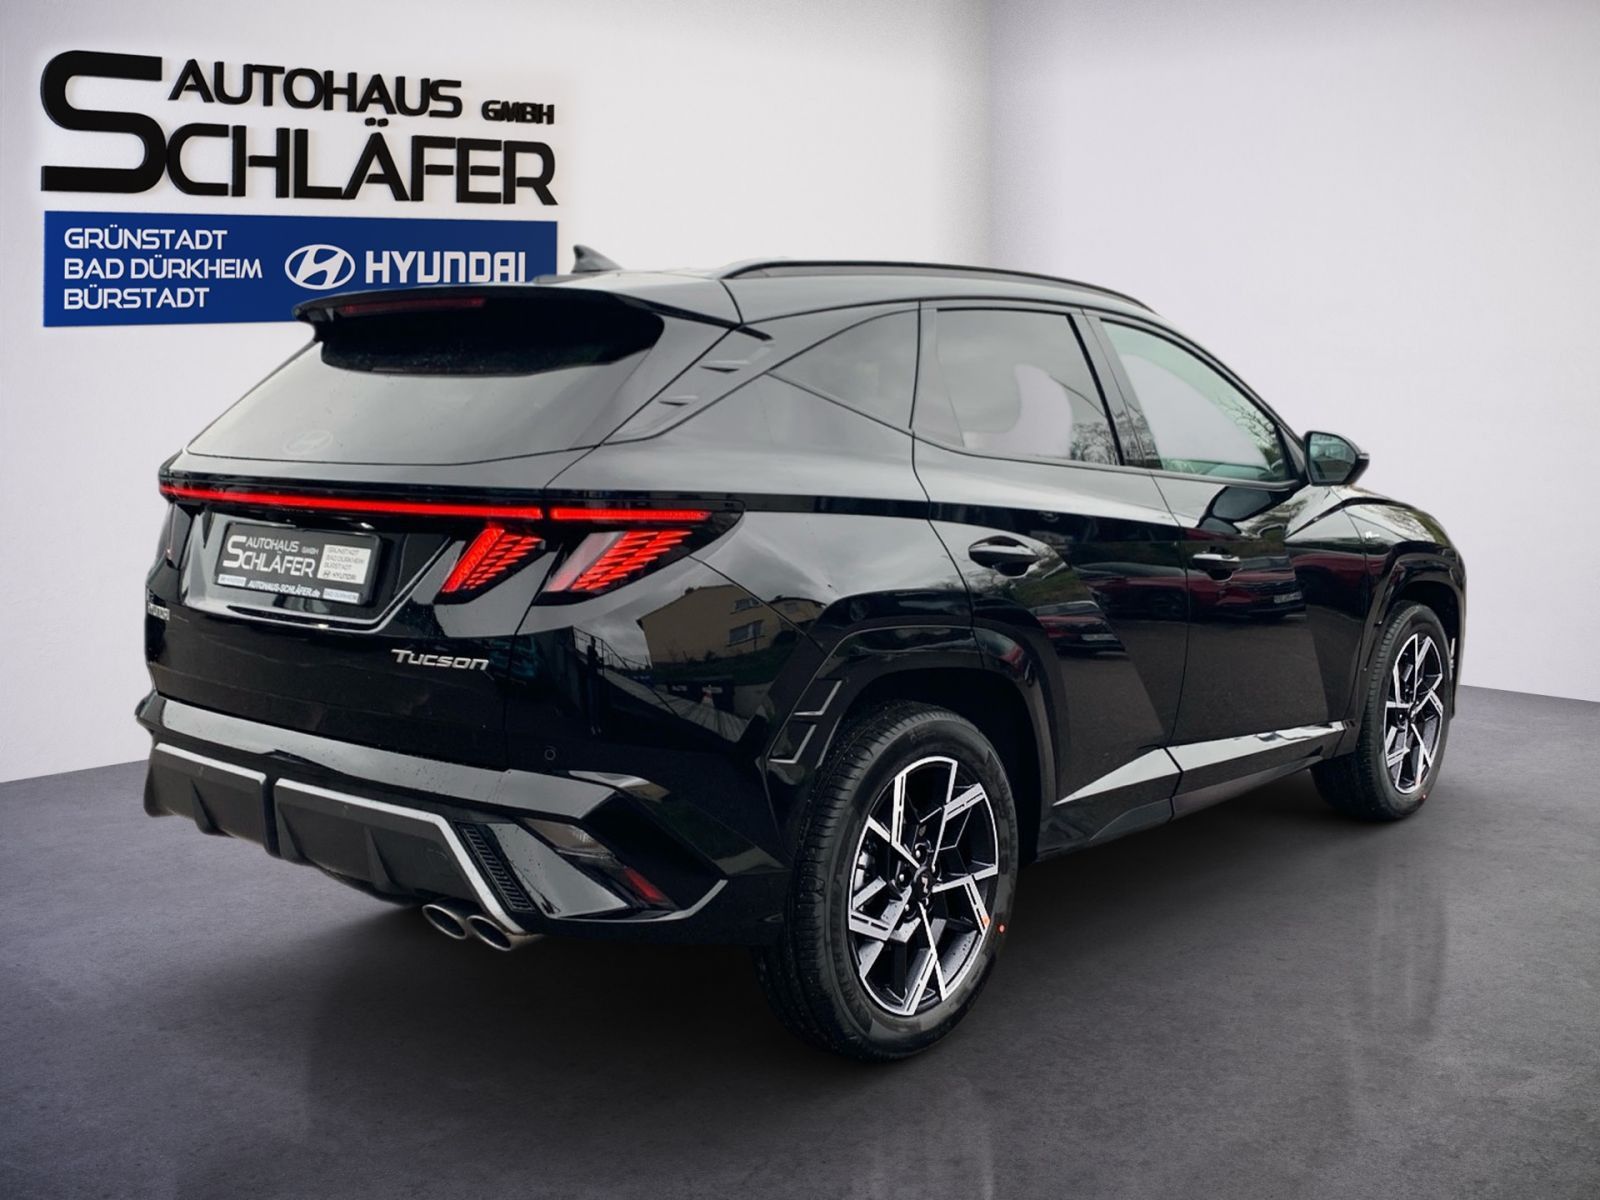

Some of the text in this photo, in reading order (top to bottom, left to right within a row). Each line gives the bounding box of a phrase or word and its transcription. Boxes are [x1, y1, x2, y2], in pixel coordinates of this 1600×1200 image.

[168, 58, 555, 125] AUTOHAUS GMBH
[40, 49, 558, 206] SCHLÄFER
[63, 224, 228, 252] GRÜNSTADT
[63, 254, 263, 281] BAD DÜRKHEIM
[364, 250, 527, 286] HYUNDAI
[63, 285, 210, 311] BÜRSTADT
[222, 535, 315, 578] SCHLÄFER
[245, 537, 299, 553] AUTOHAUS
